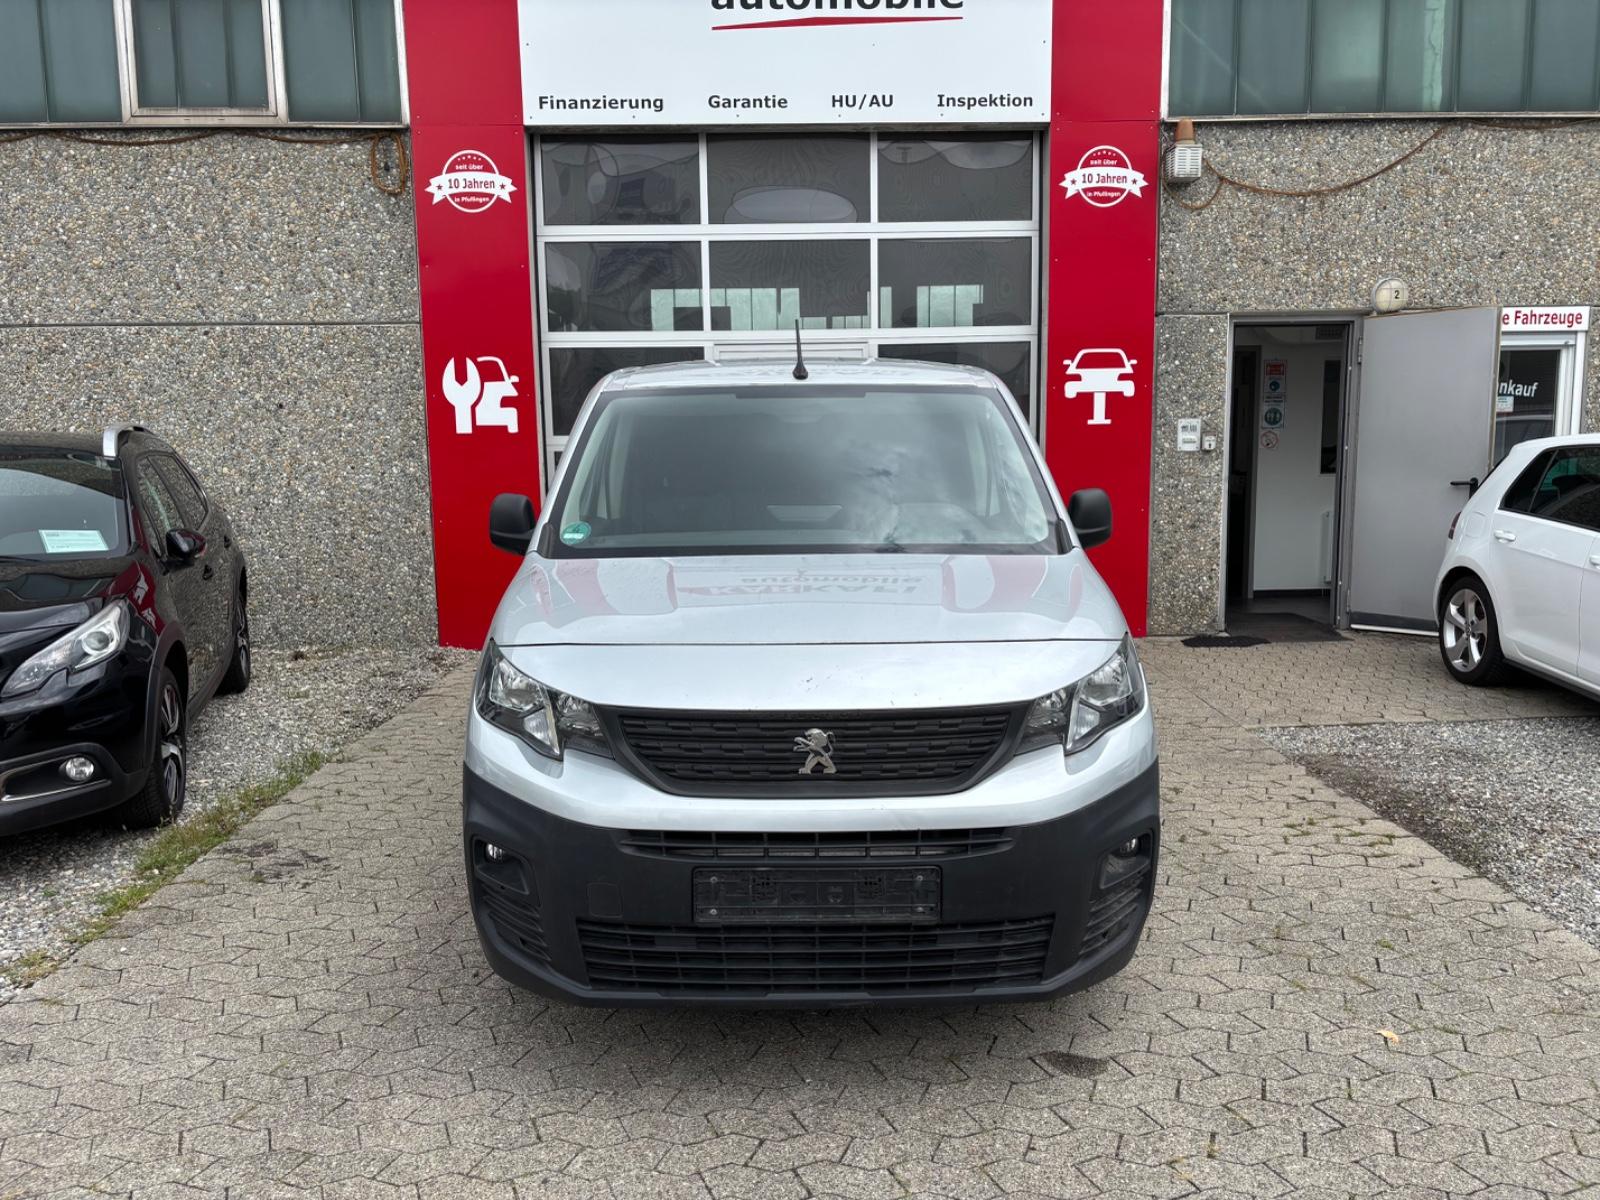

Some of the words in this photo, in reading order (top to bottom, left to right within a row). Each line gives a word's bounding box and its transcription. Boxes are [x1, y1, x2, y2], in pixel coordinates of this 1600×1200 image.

[539, 95, 664, 112] Finanzierung
[707, 95, 788, 109] Garantie
[831, 94, 894, 110] HU/AU
[937, 94, 1033, 110] Inspektion
[447, 178, 460, 189] 10
[462, 178, 495, 189] Jahren
[1081, 173, 1093, 184] 10
[1095, 173, 1128, 184] Jahren
[1394, 289, 1400, 300] 2
[1514, 309, 1583, 328] Fahrzeuge
